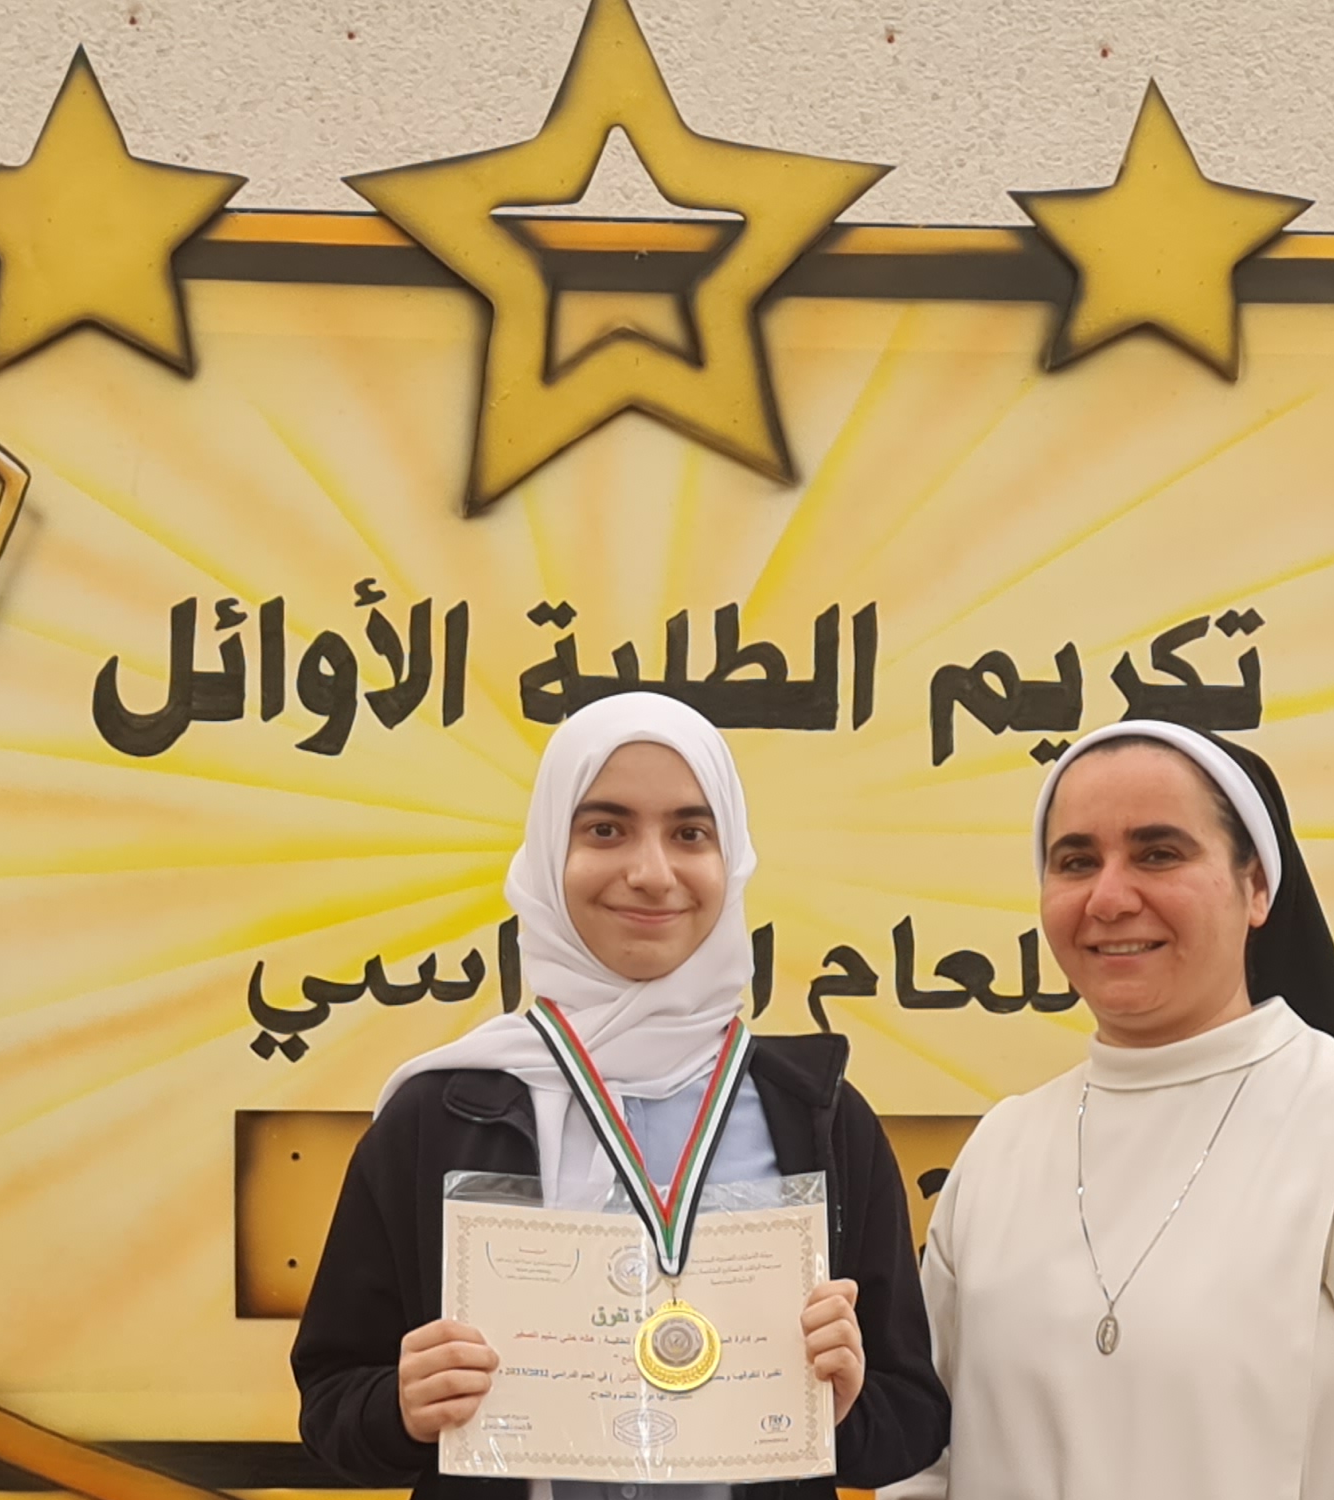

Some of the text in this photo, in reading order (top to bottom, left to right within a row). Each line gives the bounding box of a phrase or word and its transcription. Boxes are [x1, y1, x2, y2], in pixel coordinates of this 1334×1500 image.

[92, 577, 1266, 767] تكريم الطلبة الأوائل
